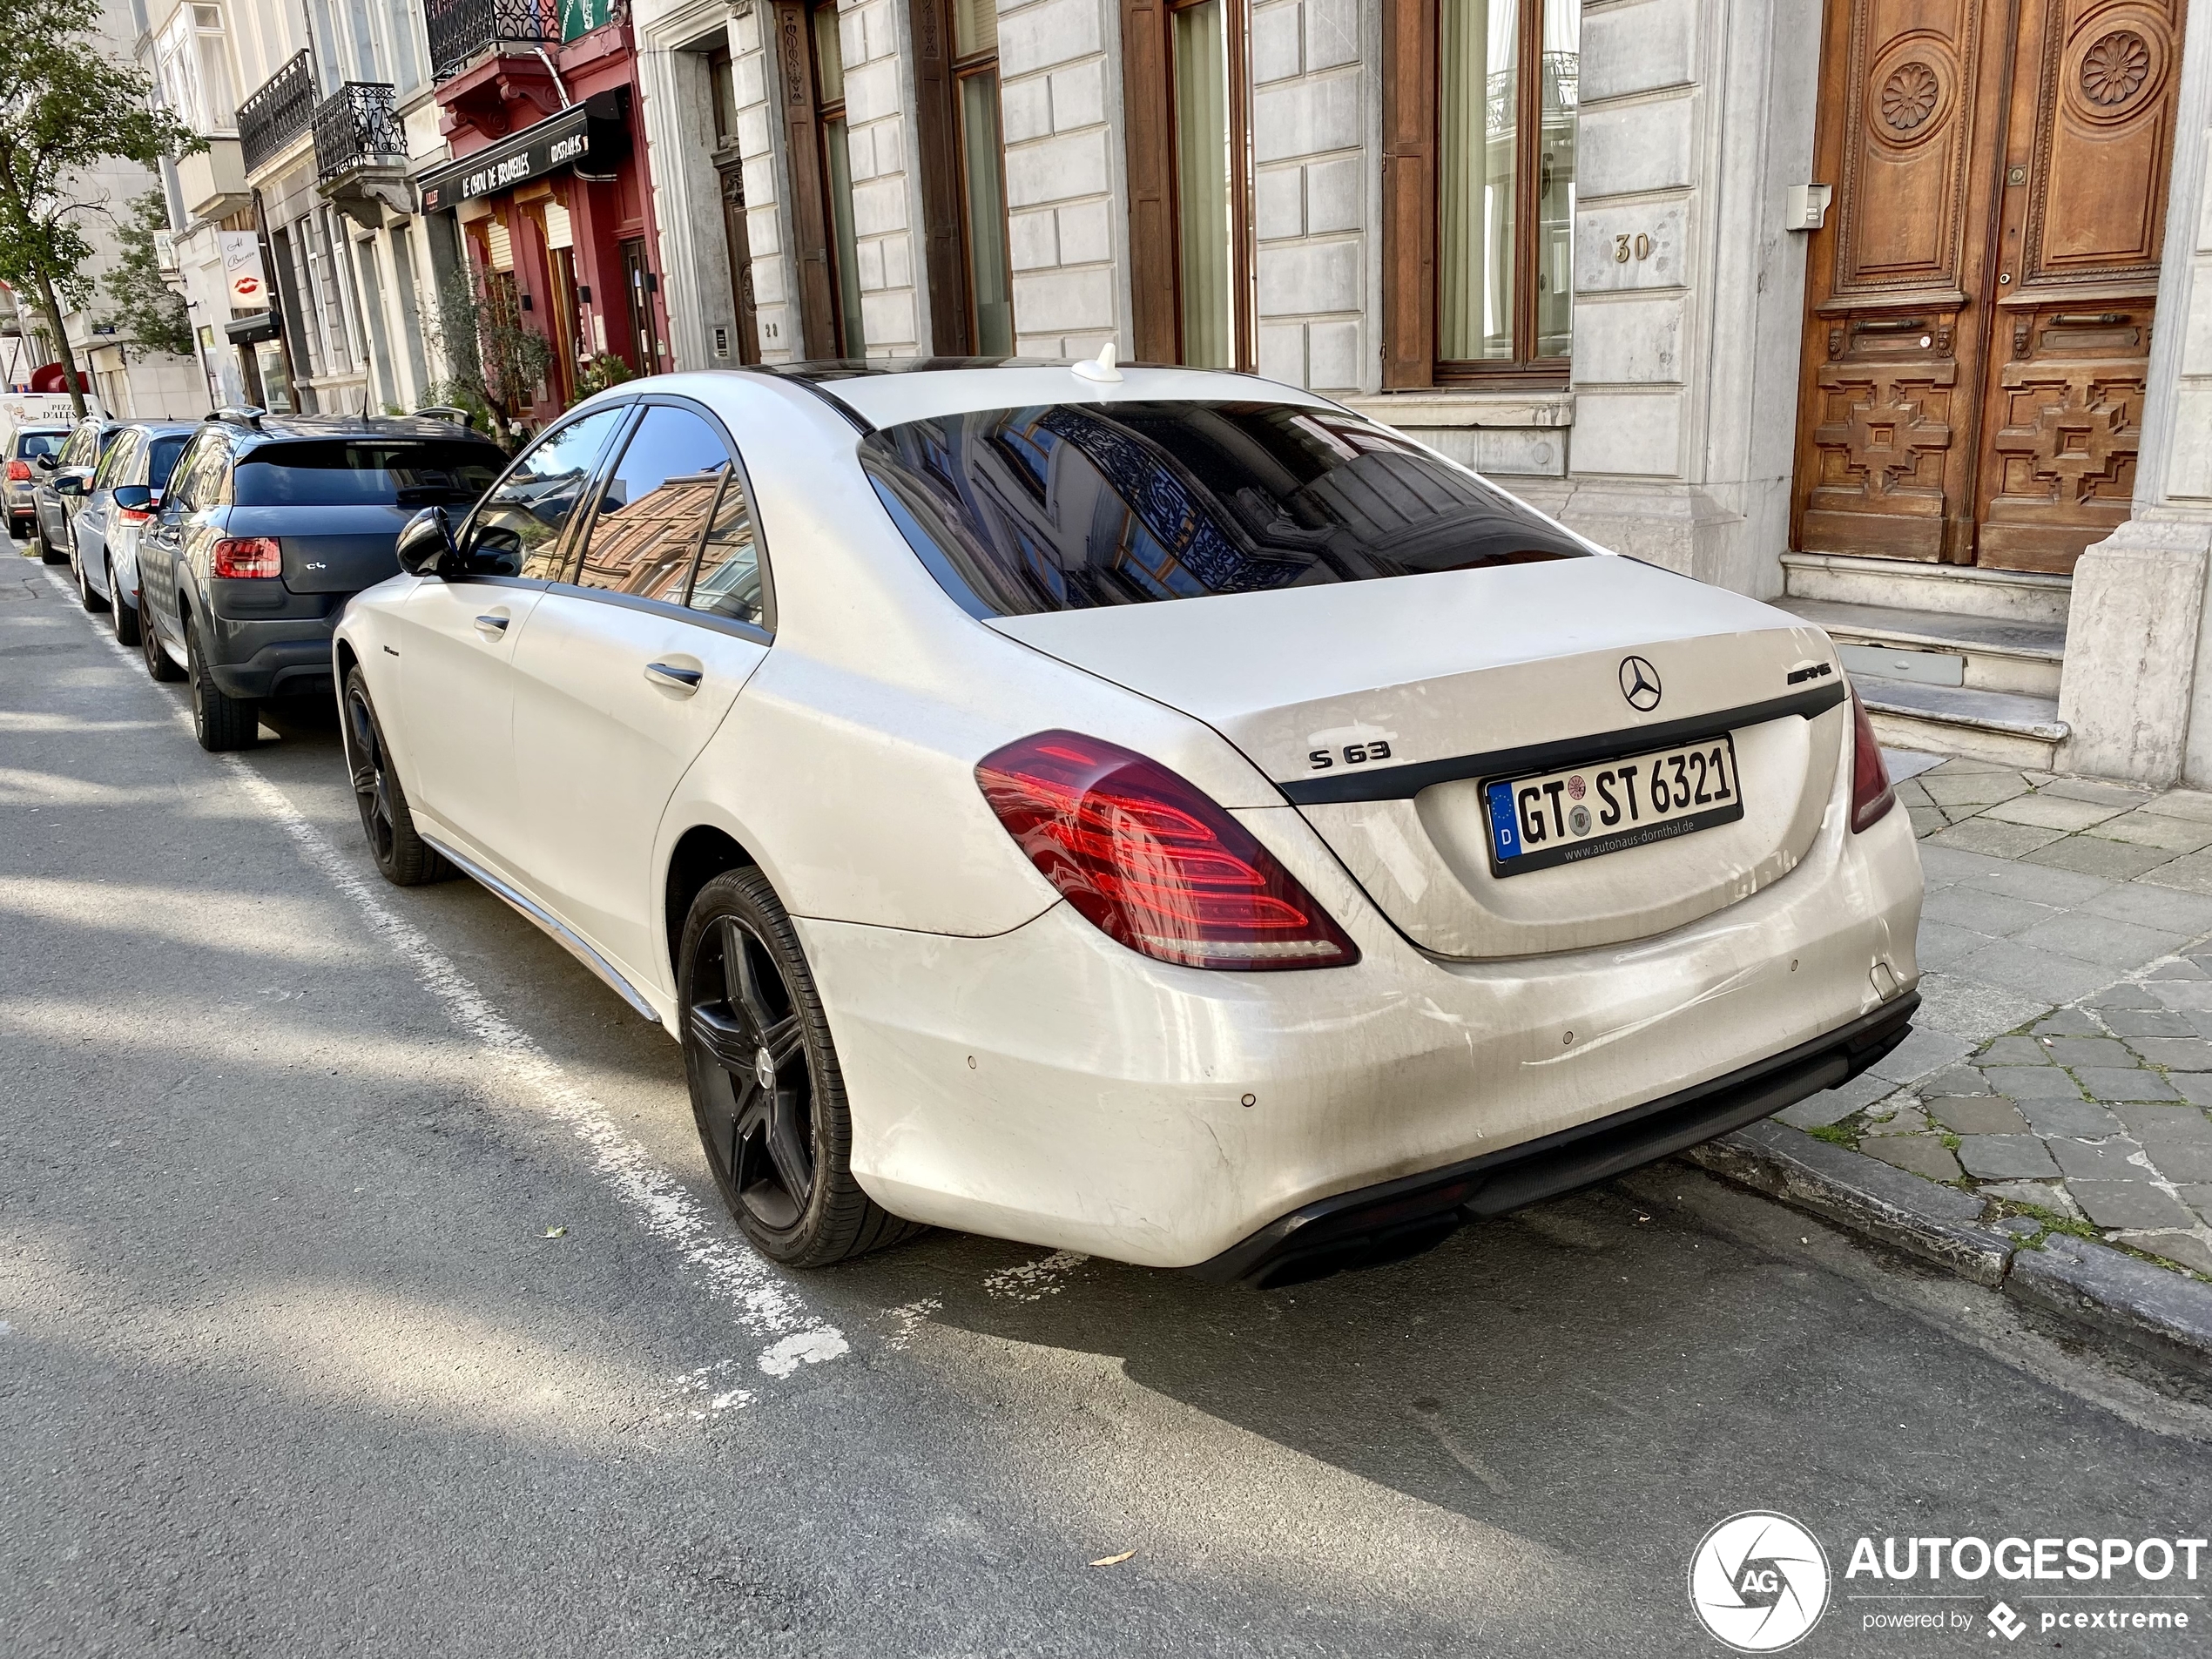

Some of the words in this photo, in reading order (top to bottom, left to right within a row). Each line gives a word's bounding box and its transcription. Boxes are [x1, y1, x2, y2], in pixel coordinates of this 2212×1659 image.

[462, 177, 470, 198] LE
[471, 170, 487, 194] CHOU
[488, 165, 496, 189] DE
[497, 152, 530, 185] BRUXELLES
[227, 237, 243, 252] Al
[1615, 233, 1649, 263] 30
[1309, 749, 1333, 770] S
[1343, 740, 1392, 764] 63
[1518, 780, 1565, 844] GT
[1595, 765, 1638, 826] ST
[1650, 747, 1731, 813] 6321
[1501, 828, 1512, 846] D
[1564, 820, 1695, 861] www.autohaus-dornthal.de
